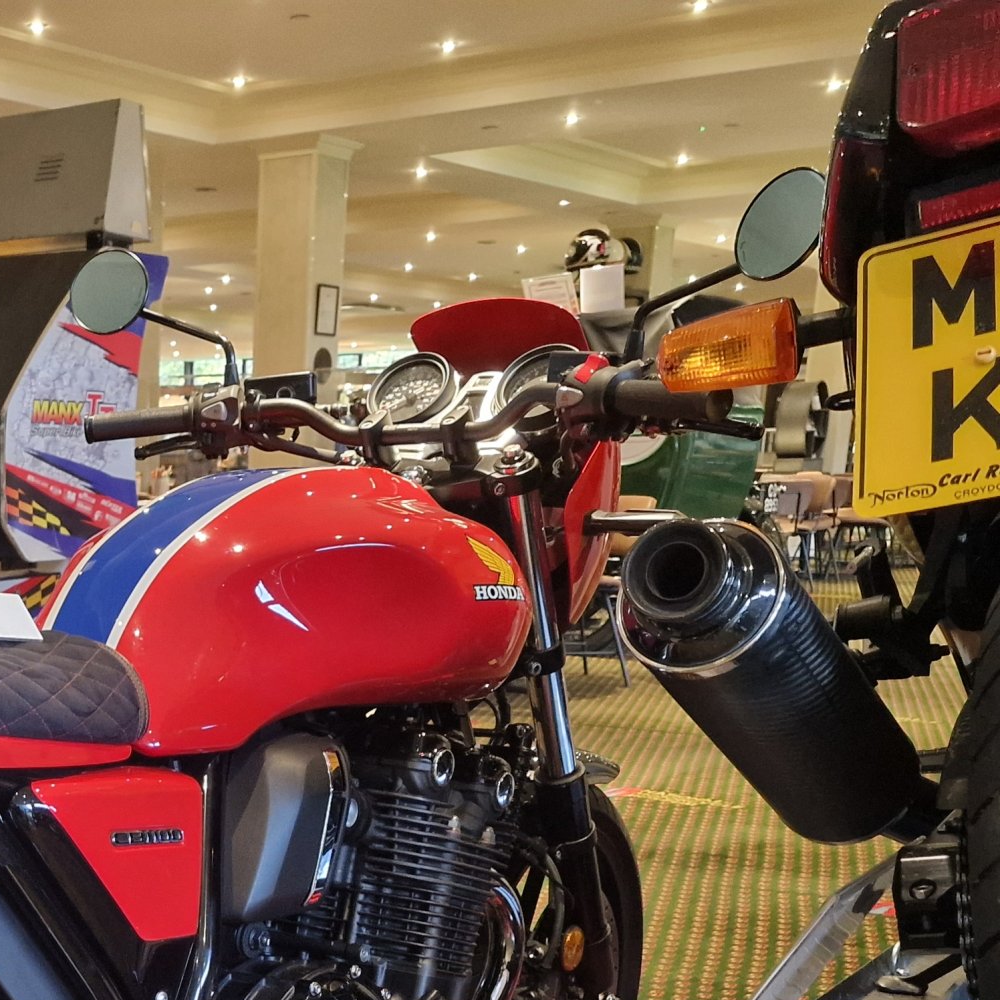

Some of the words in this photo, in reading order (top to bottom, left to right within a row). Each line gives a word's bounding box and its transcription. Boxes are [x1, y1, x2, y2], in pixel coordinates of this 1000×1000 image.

[911, 239, 997, 350] M
[32, 399, 83, 425] MANX
[938, 467, 980, 488] Carl
[868, 482, 937, 508] Norton
[473, 584, 525, 601] HONDA
